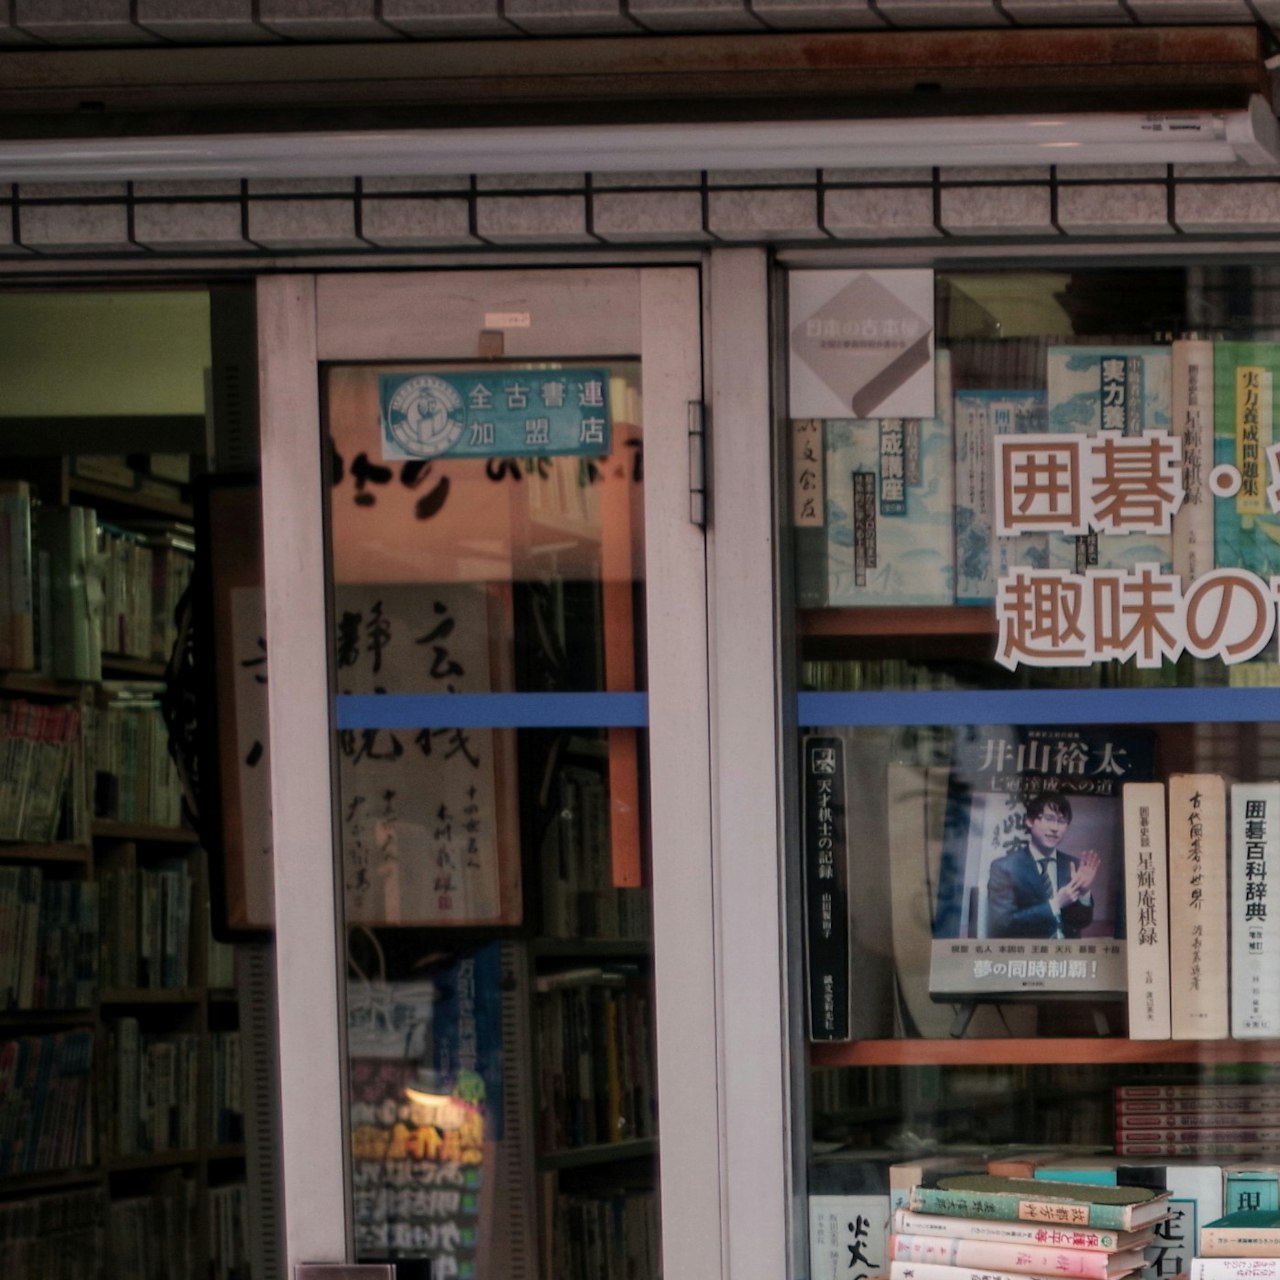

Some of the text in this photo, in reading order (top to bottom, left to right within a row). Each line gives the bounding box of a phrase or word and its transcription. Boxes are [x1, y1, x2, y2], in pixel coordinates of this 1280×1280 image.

[469, 380, 605, 410] 全古書連
[469, 416, 605, 447] 加盟店
[978, 740, 1126, 775] 井山裕太
[1245, 800, 1267, 922] 囲碁百科辞典
